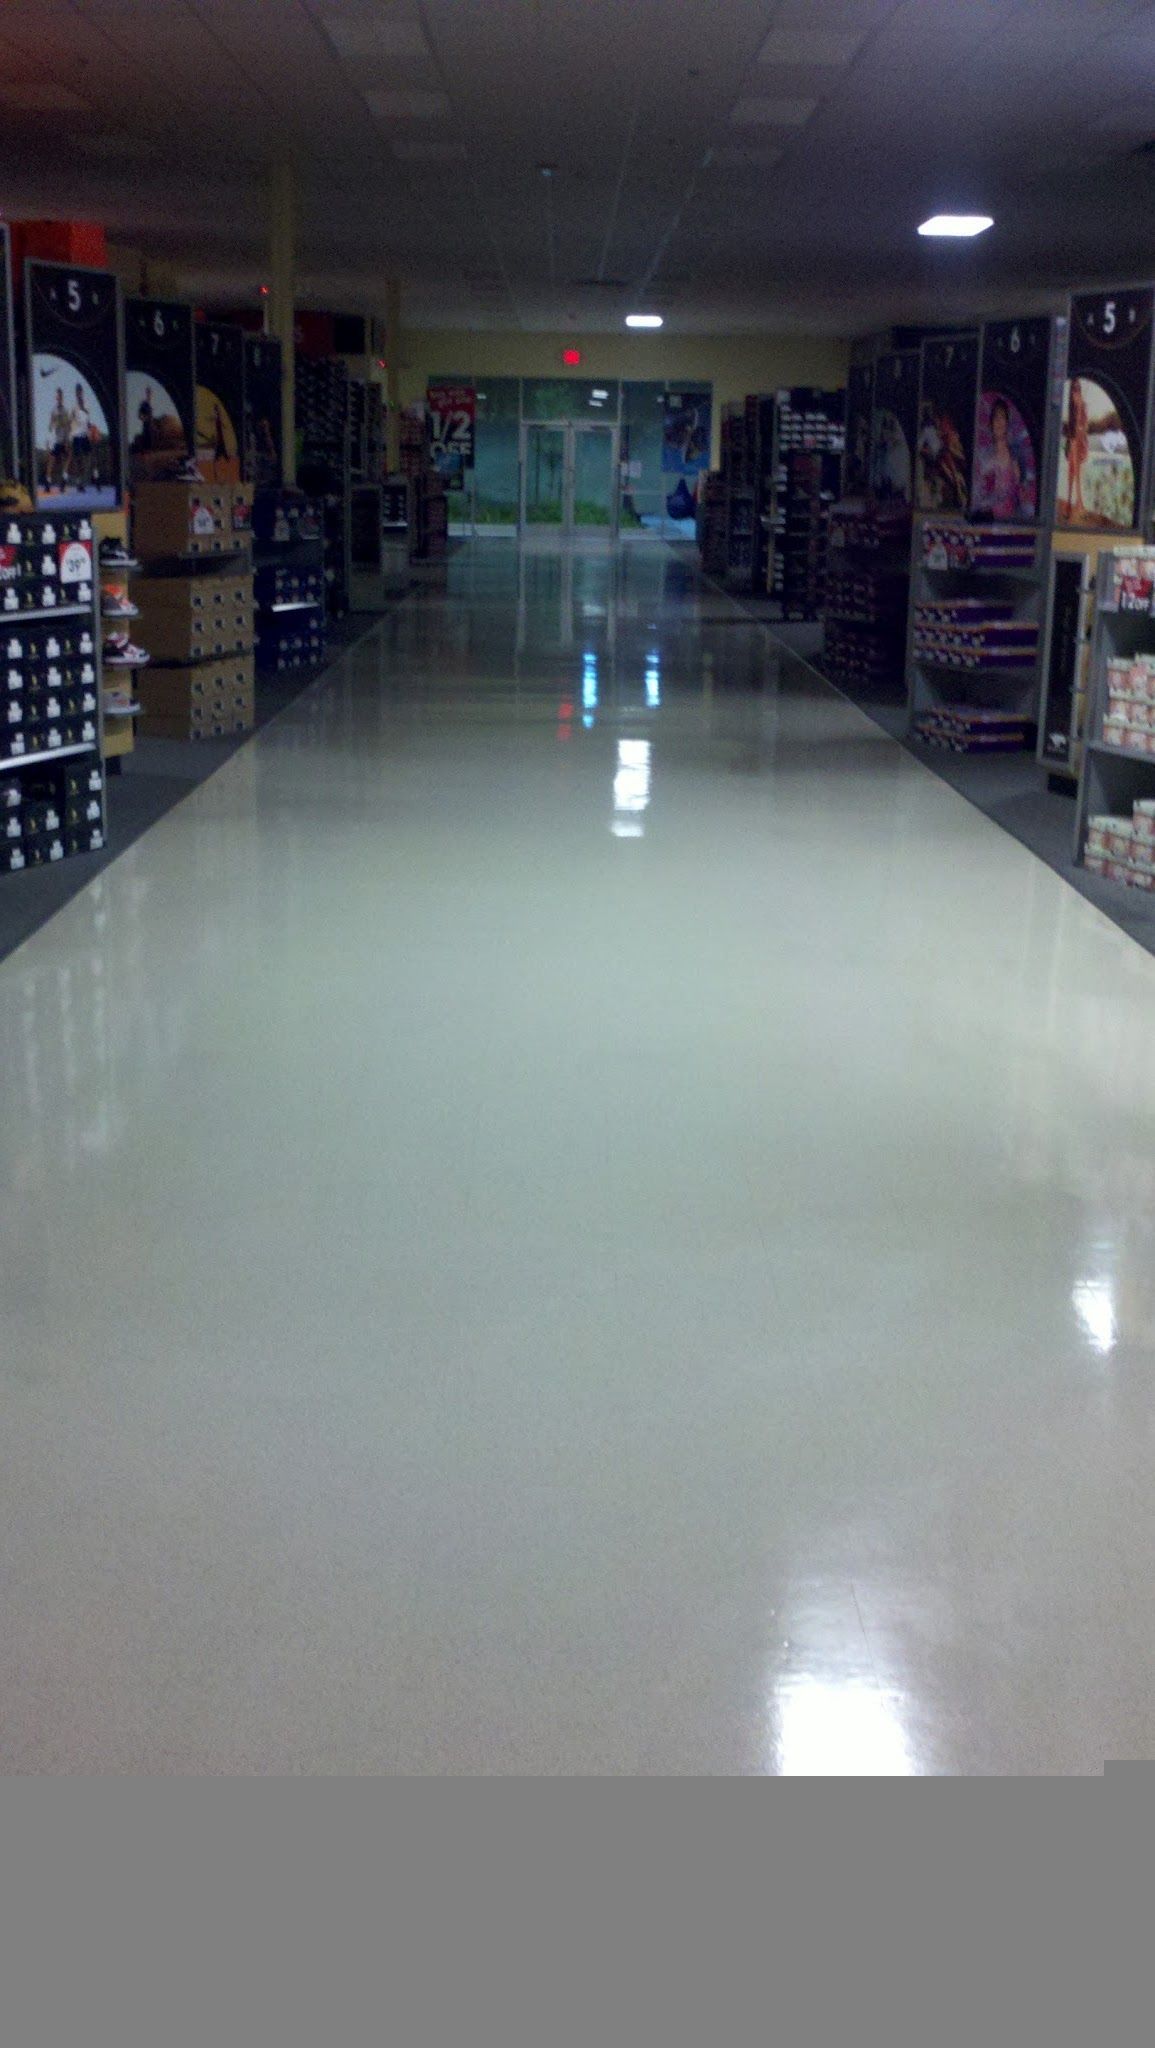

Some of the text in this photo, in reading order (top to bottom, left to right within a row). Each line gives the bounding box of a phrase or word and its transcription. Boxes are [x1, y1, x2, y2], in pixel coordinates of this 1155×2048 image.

[67, 279, 81, 311] 5
[153, 309, 165, 337] 6
[1103, 301, 1116, 334] 5
[1010, 326, 1021, 353] 6
[431, 409, 472, 442] 1/2
